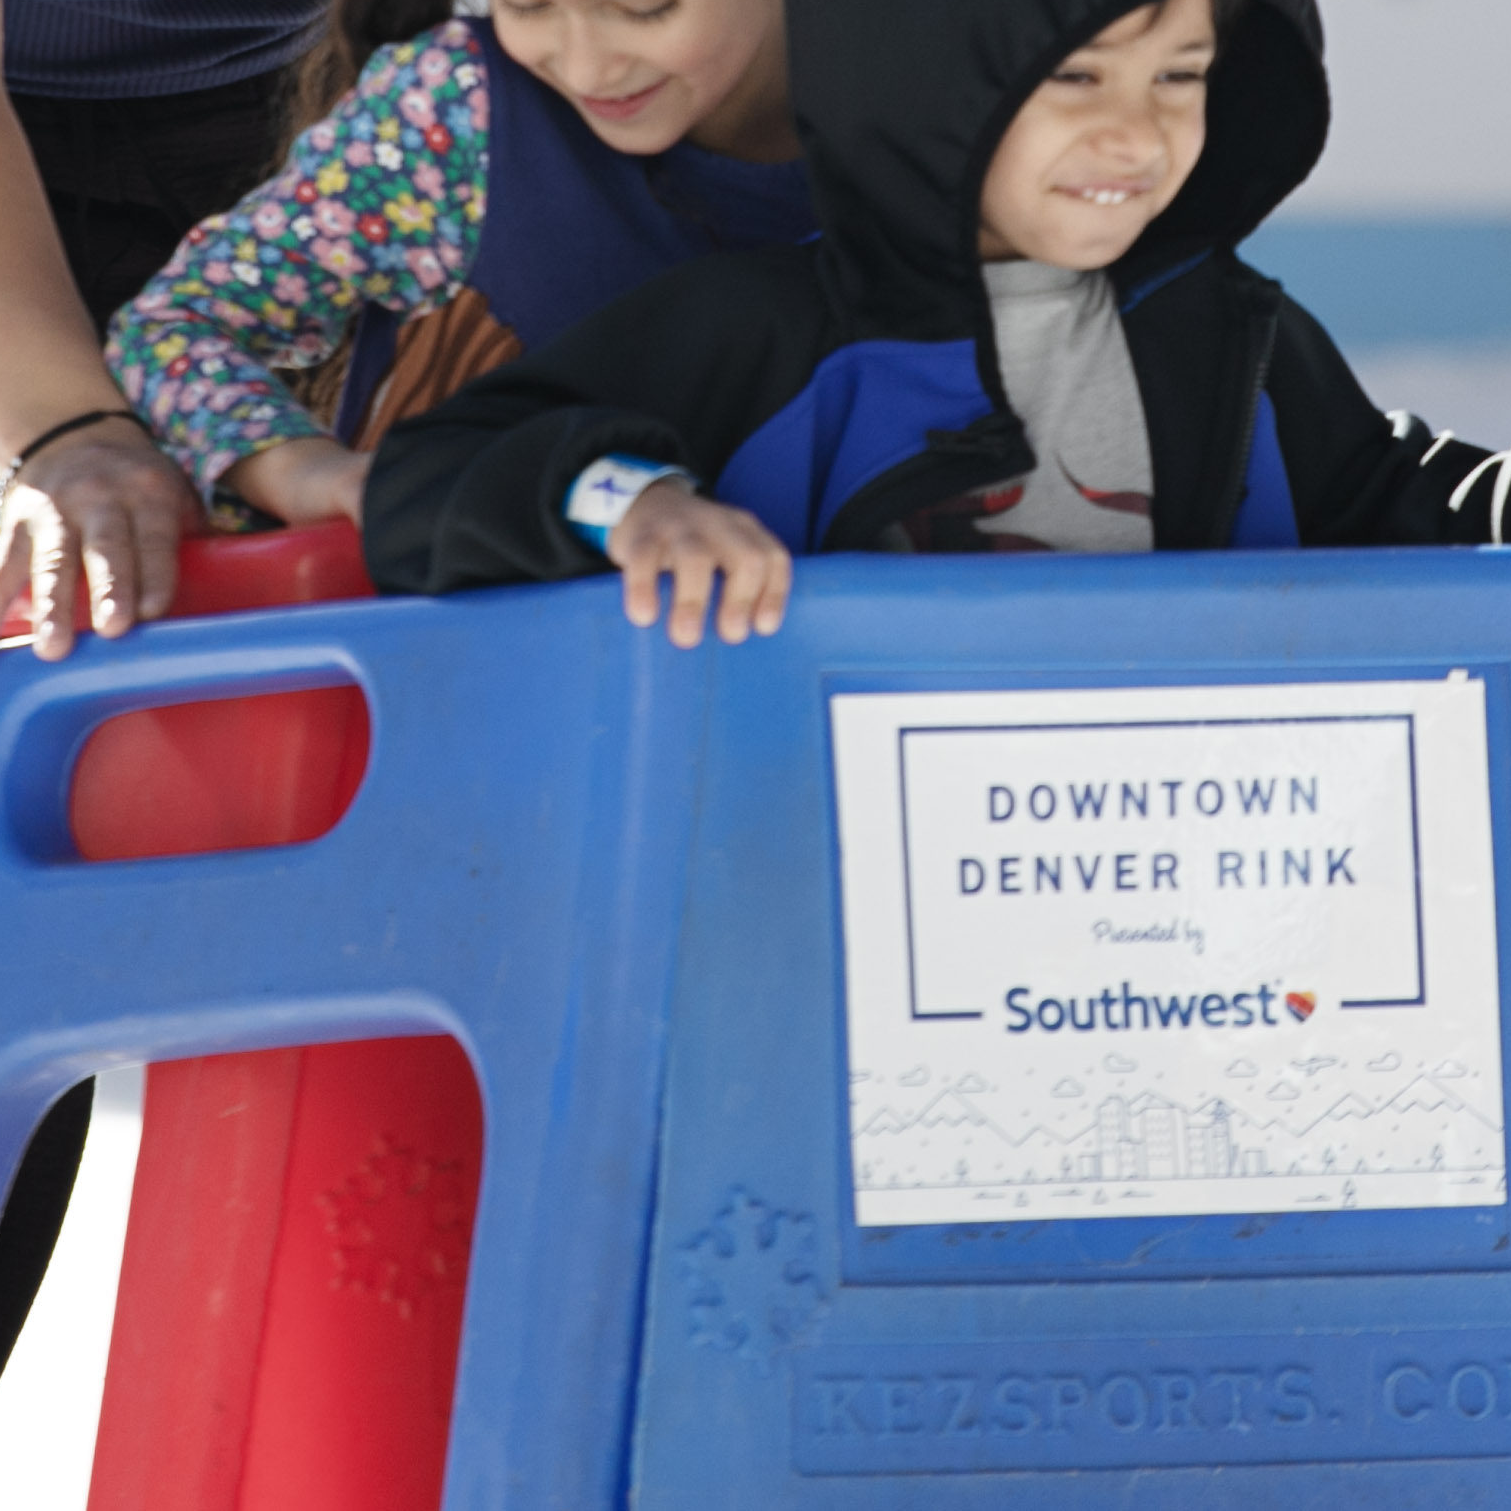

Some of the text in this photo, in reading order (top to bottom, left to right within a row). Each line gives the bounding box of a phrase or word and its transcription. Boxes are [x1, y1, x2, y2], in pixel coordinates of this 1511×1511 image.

[988, 776, 1320, 823] DOWNTOWN
[957, 847, 1358, 897] DENVER RINK
[1092, 917, 1207, 956] Presented by
[1004, 980, 1279, 1034] Southwest
